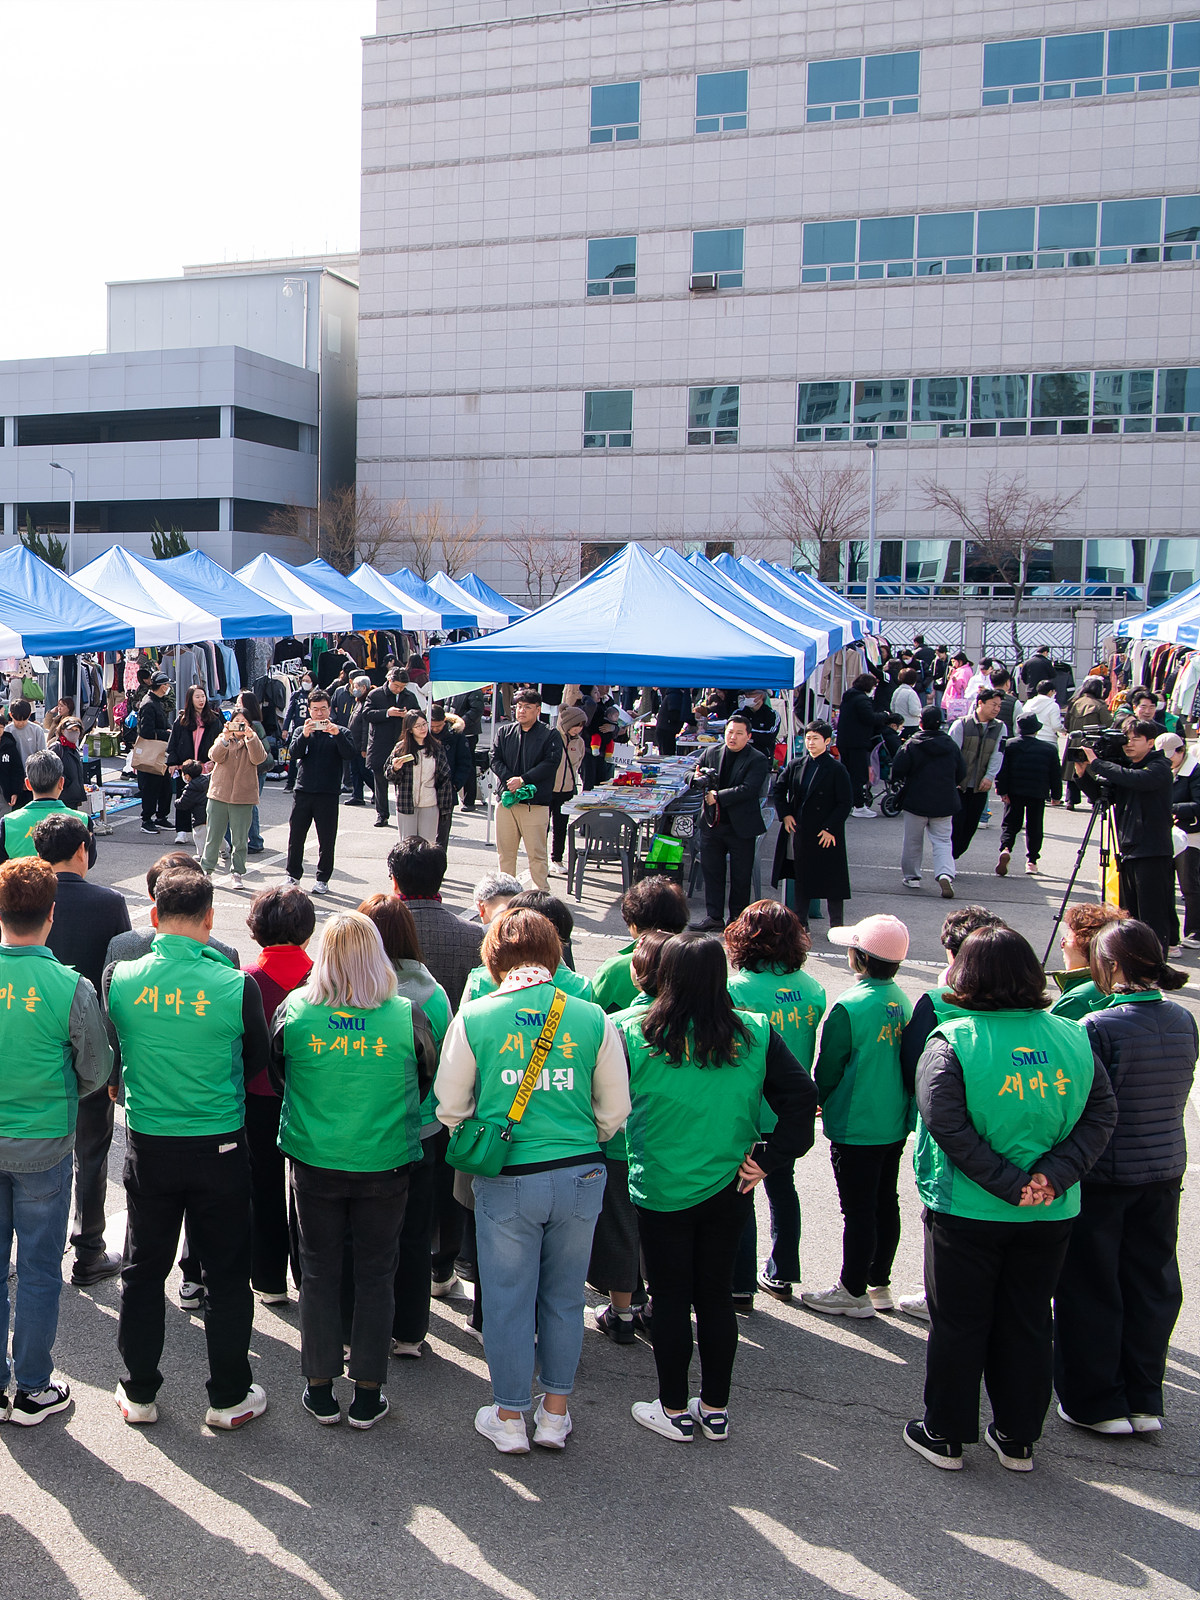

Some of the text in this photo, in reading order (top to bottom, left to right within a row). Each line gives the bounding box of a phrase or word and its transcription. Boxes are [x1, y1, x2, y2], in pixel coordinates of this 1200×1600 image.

[134, 985, 211, 1016] 새마을
[775, 990, 802, 1004] SMU
[328, 1016, 366, 1031] SMU
[770, 1005, 816, 1031] 새마을
[886, 1005, 904, 1019] SMU
[499, 1032, 578, 1059] 새을
[877, 1022, 909, 1046] 새마
[1011, 1050, 1049, 1066] SMU
[998, 1068, 1071, 1100] 새마을
